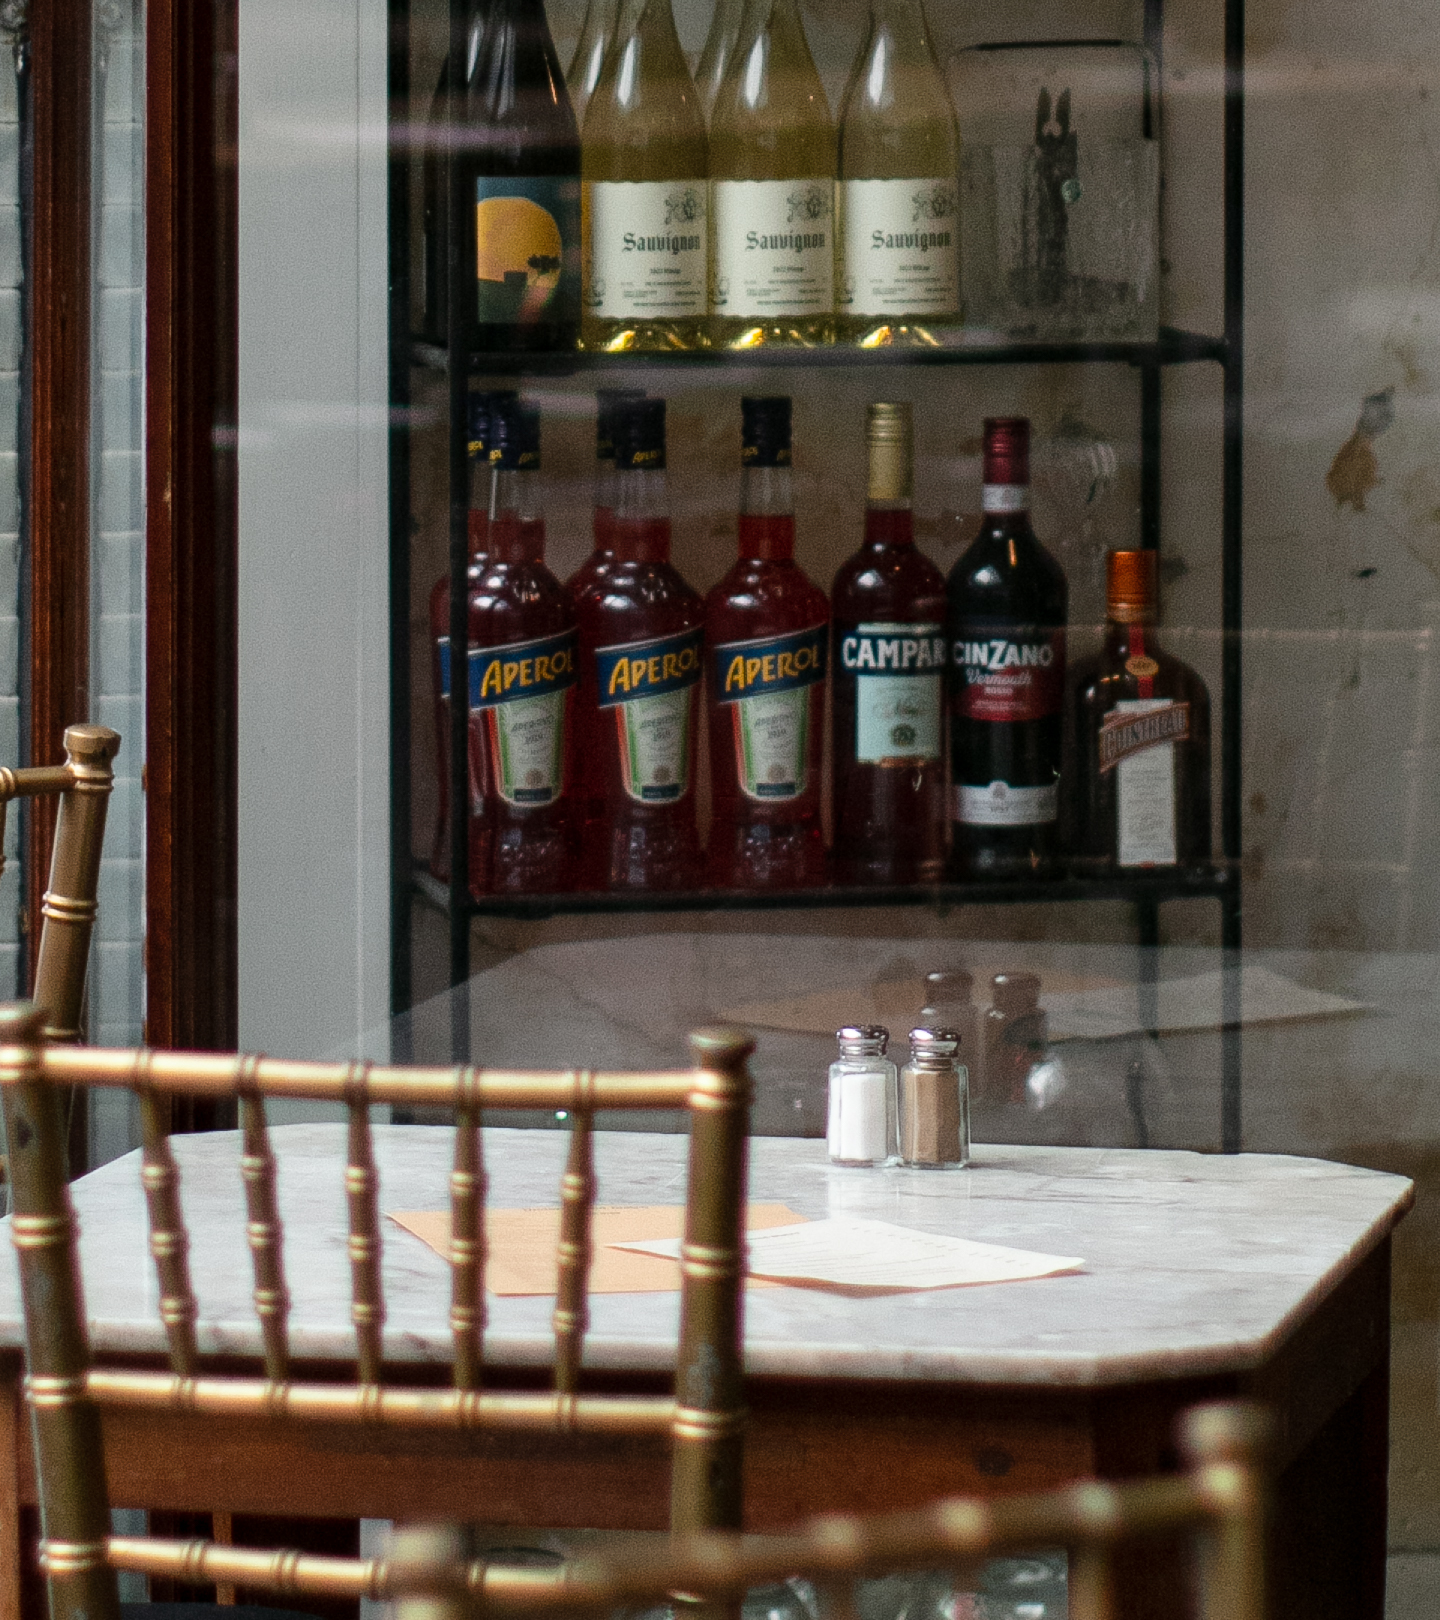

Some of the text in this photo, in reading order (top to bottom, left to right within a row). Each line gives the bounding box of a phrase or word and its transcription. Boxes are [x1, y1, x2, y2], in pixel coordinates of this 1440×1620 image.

[622, 232, 700, 255] Sauvignon
[745, 230, 826, 253] Sauvignon
[871, 229, 951, 253] Sauvignon
[954, 639, 1054, 670] CINZANO
[481, 648, 573, 698] APEROL
[609, 646, 700, 695] APEROL
[725, 645, 820, 692] APEROL
[966, 668, 1033, 686] Vermouth
